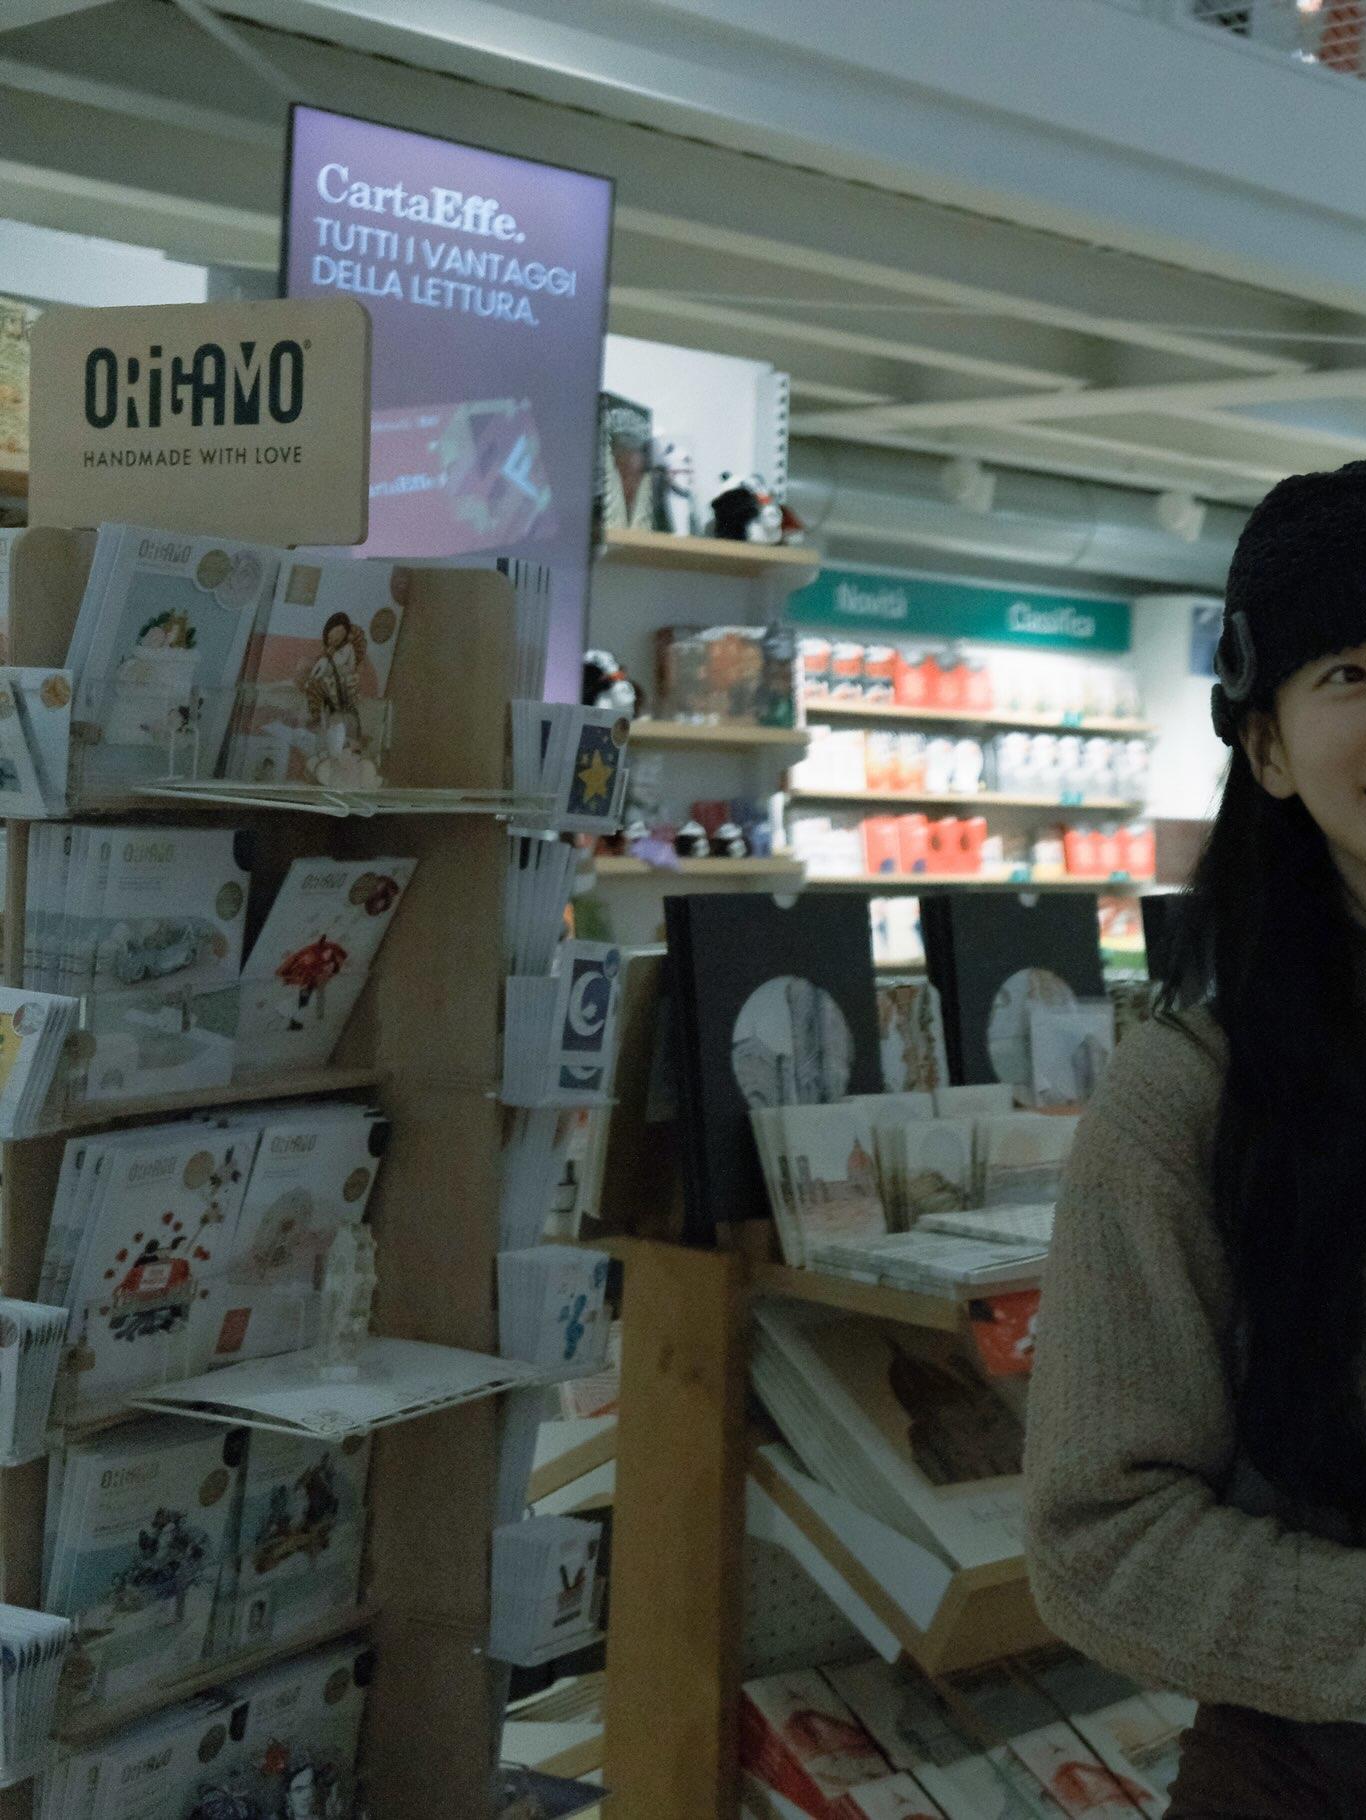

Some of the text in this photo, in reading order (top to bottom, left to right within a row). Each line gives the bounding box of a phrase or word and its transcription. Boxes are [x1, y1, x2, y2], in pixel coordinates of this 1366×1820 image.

[316, 163, 526, 244] CartaEffe.
[312, 255, 404, 300] DELLA
[313, 216, 577, 297] TUTTI I VANTAGGI
[84, 446, 303, 467] HANDMADE WITH LOVE
